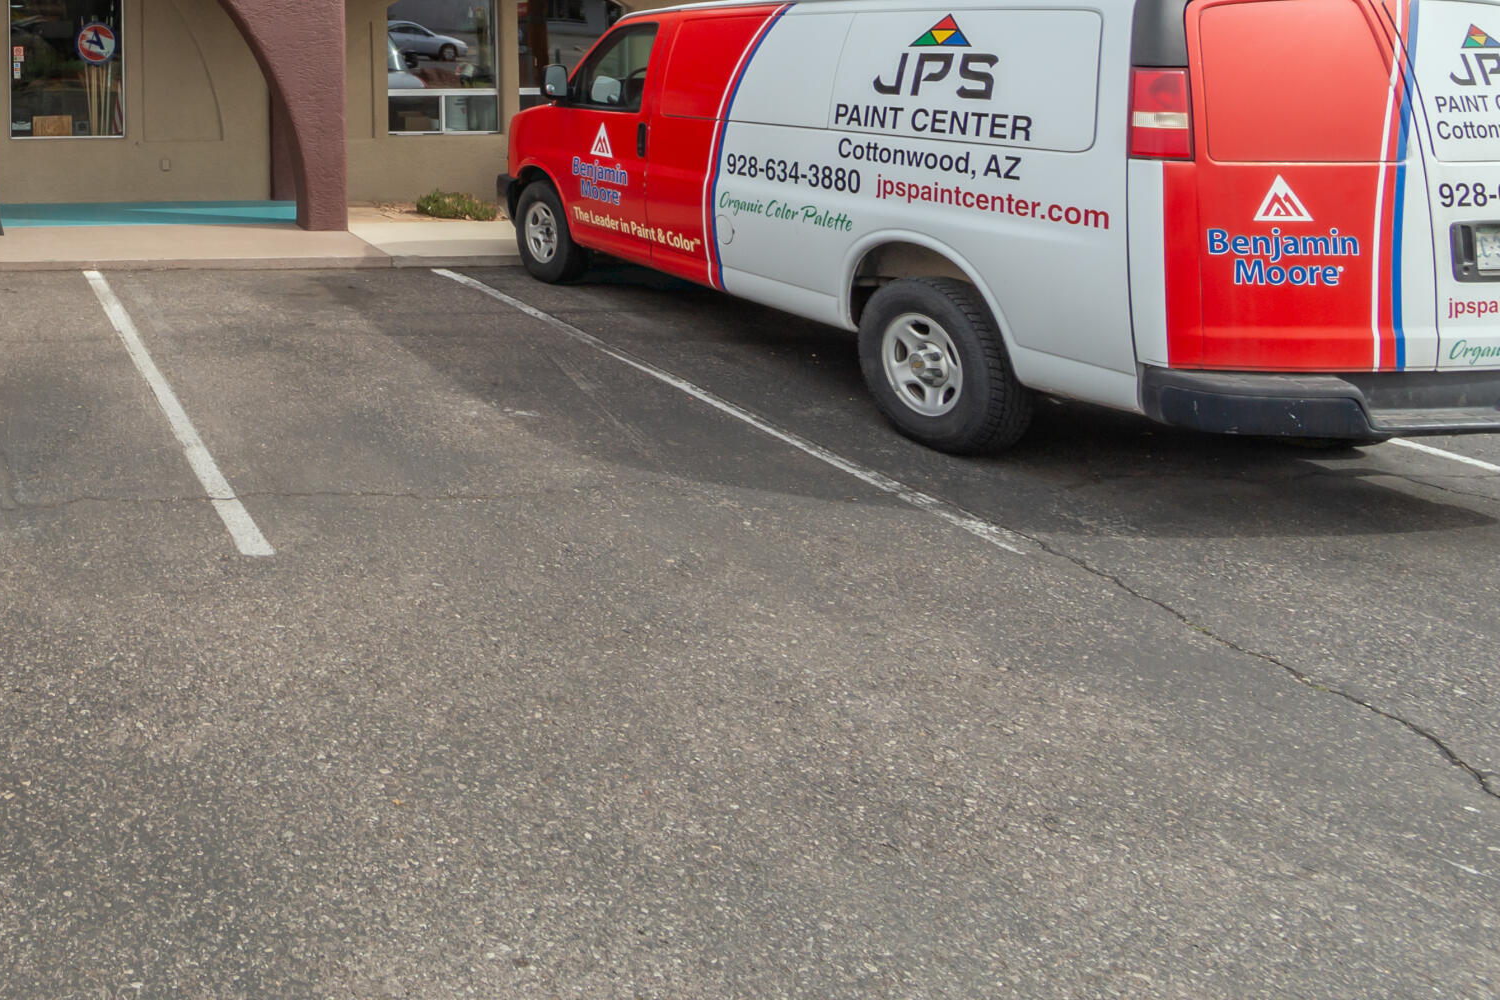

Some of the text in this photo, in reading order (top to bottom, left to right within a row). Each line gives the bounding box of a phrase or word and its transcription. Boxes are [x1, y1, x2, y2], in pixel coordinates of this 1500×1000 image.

[873, 53, 999, 100] JPS
[1434, 95, 1488, 113] PAINT
[834, 103, 1033, 141] PAINT CENTER
[1436, 120, 1500, 140] Cotton
[572, 156, 628, 186] Benjamin
[838, 137, 1022, 181] Cottonwood, AZ
[580, 179, 620, 205] Moore
[727, 153, 1110, 230] 928-634-3880 jpspaintcenter.com
[1439, 183, 1500, 208] 928-
[573, 206, 590, 223] The
[590, 209, 619, 231] Leader
[620, 218, 630, 234] in
[630, 221, 657, 242] Paint
[657, 228, 666, 244] &
[719, 191, 853, 232] Organic Color Palette
[1207, 227, 1360, 263] Benjamin
[1234, 258, 1340, 286] Moore
[1448, 297, 1499, 319] jpspa
